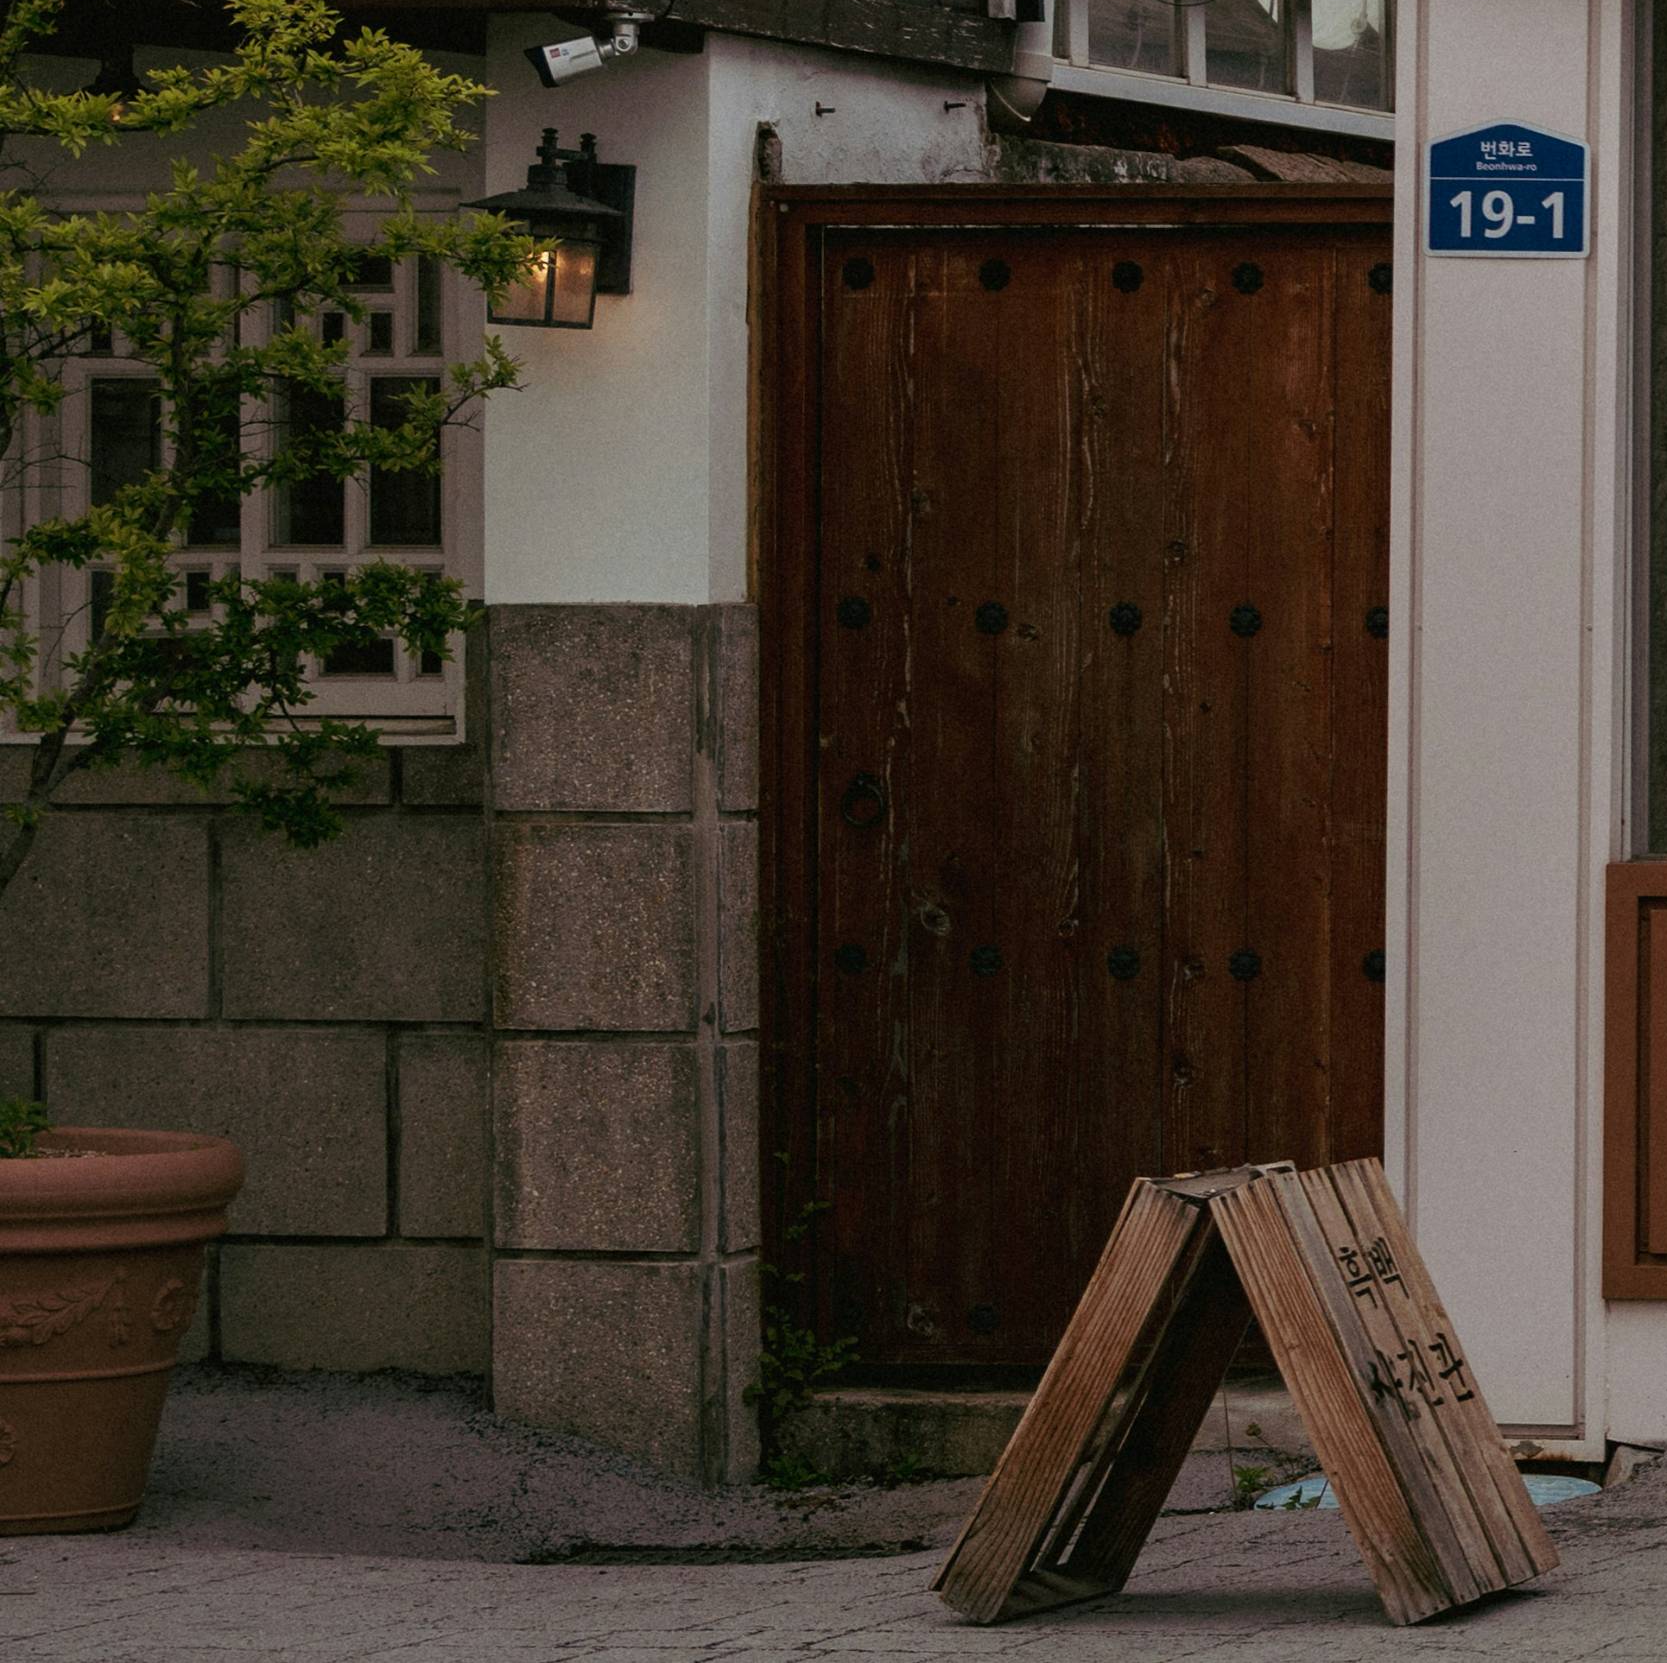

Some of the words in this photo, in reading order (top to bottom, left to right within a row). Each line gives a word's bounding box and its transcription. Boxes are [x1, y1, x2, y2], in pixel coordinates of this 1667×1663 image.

[1476, 161, 1537, 171] Beonhwa-ro
[1480, 140, 1534, 160] 번화로
[1450, 190, 1564, 239] 19-1
[1338, 1236, 1410, 1310] 흑백
[1366, 1332, 1475, 1408] 사진관
